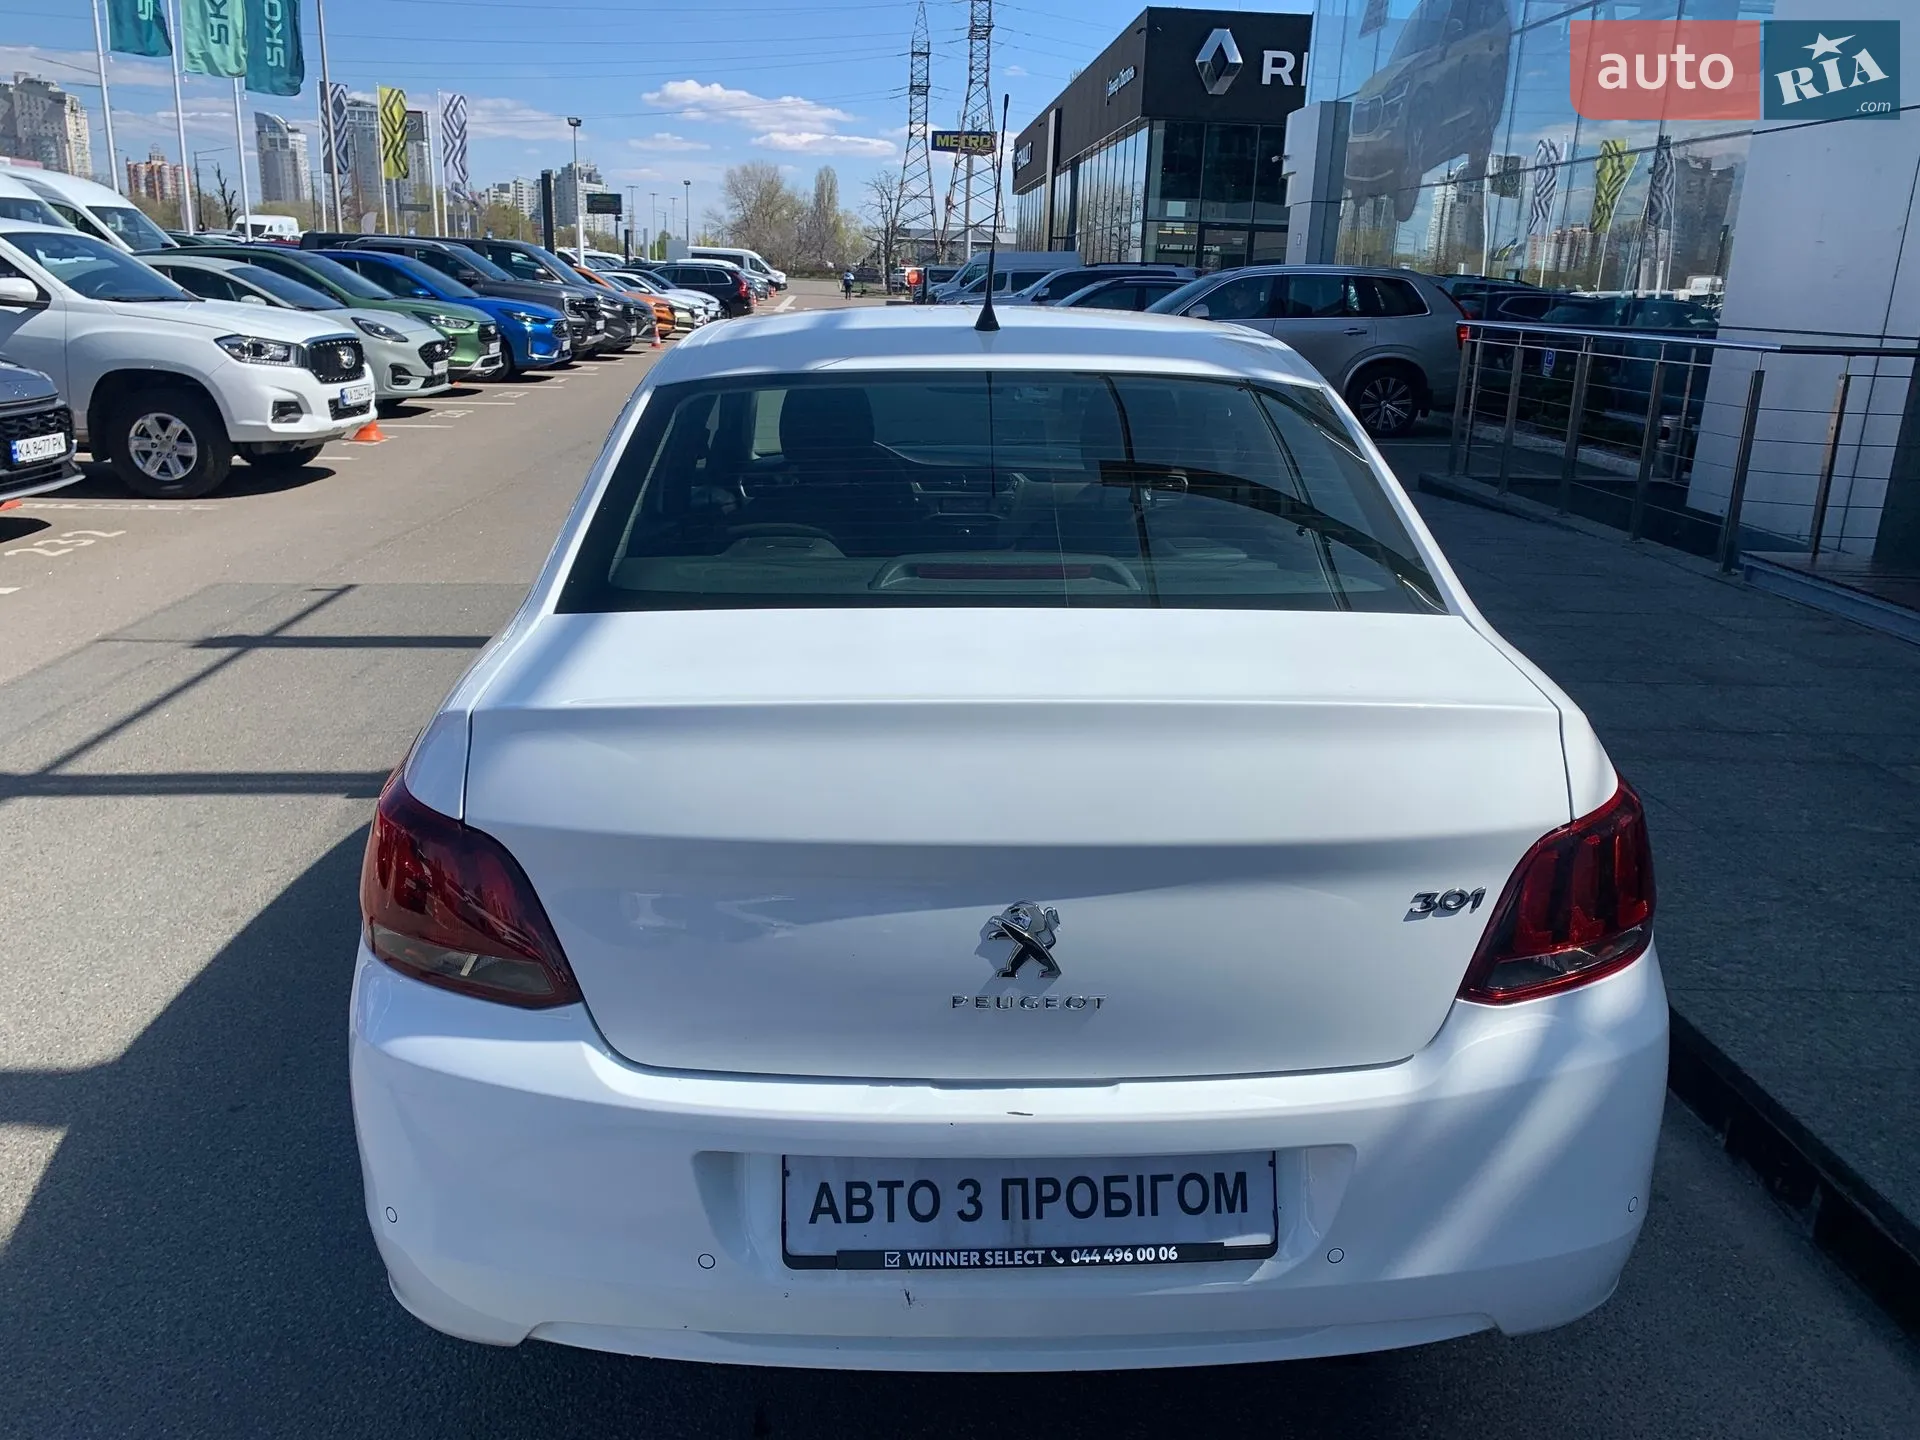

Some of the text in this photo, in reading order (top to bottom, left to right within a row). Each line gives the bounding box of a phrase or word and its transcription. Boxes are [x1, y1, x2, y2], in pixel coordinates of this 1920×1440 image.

[936, 134, 992, 148] METRO
[1410, 886, 1487, 914] 301
[951, 994, 1108, 1010] PEUGEOT
[808, 1180, 942, 1226] АВТО
[1001, 1170, 1250, 1223] ПРОБІГОМ
[907, 1246, 1179, 1267] WINNER SELECT 044 496 00 06
